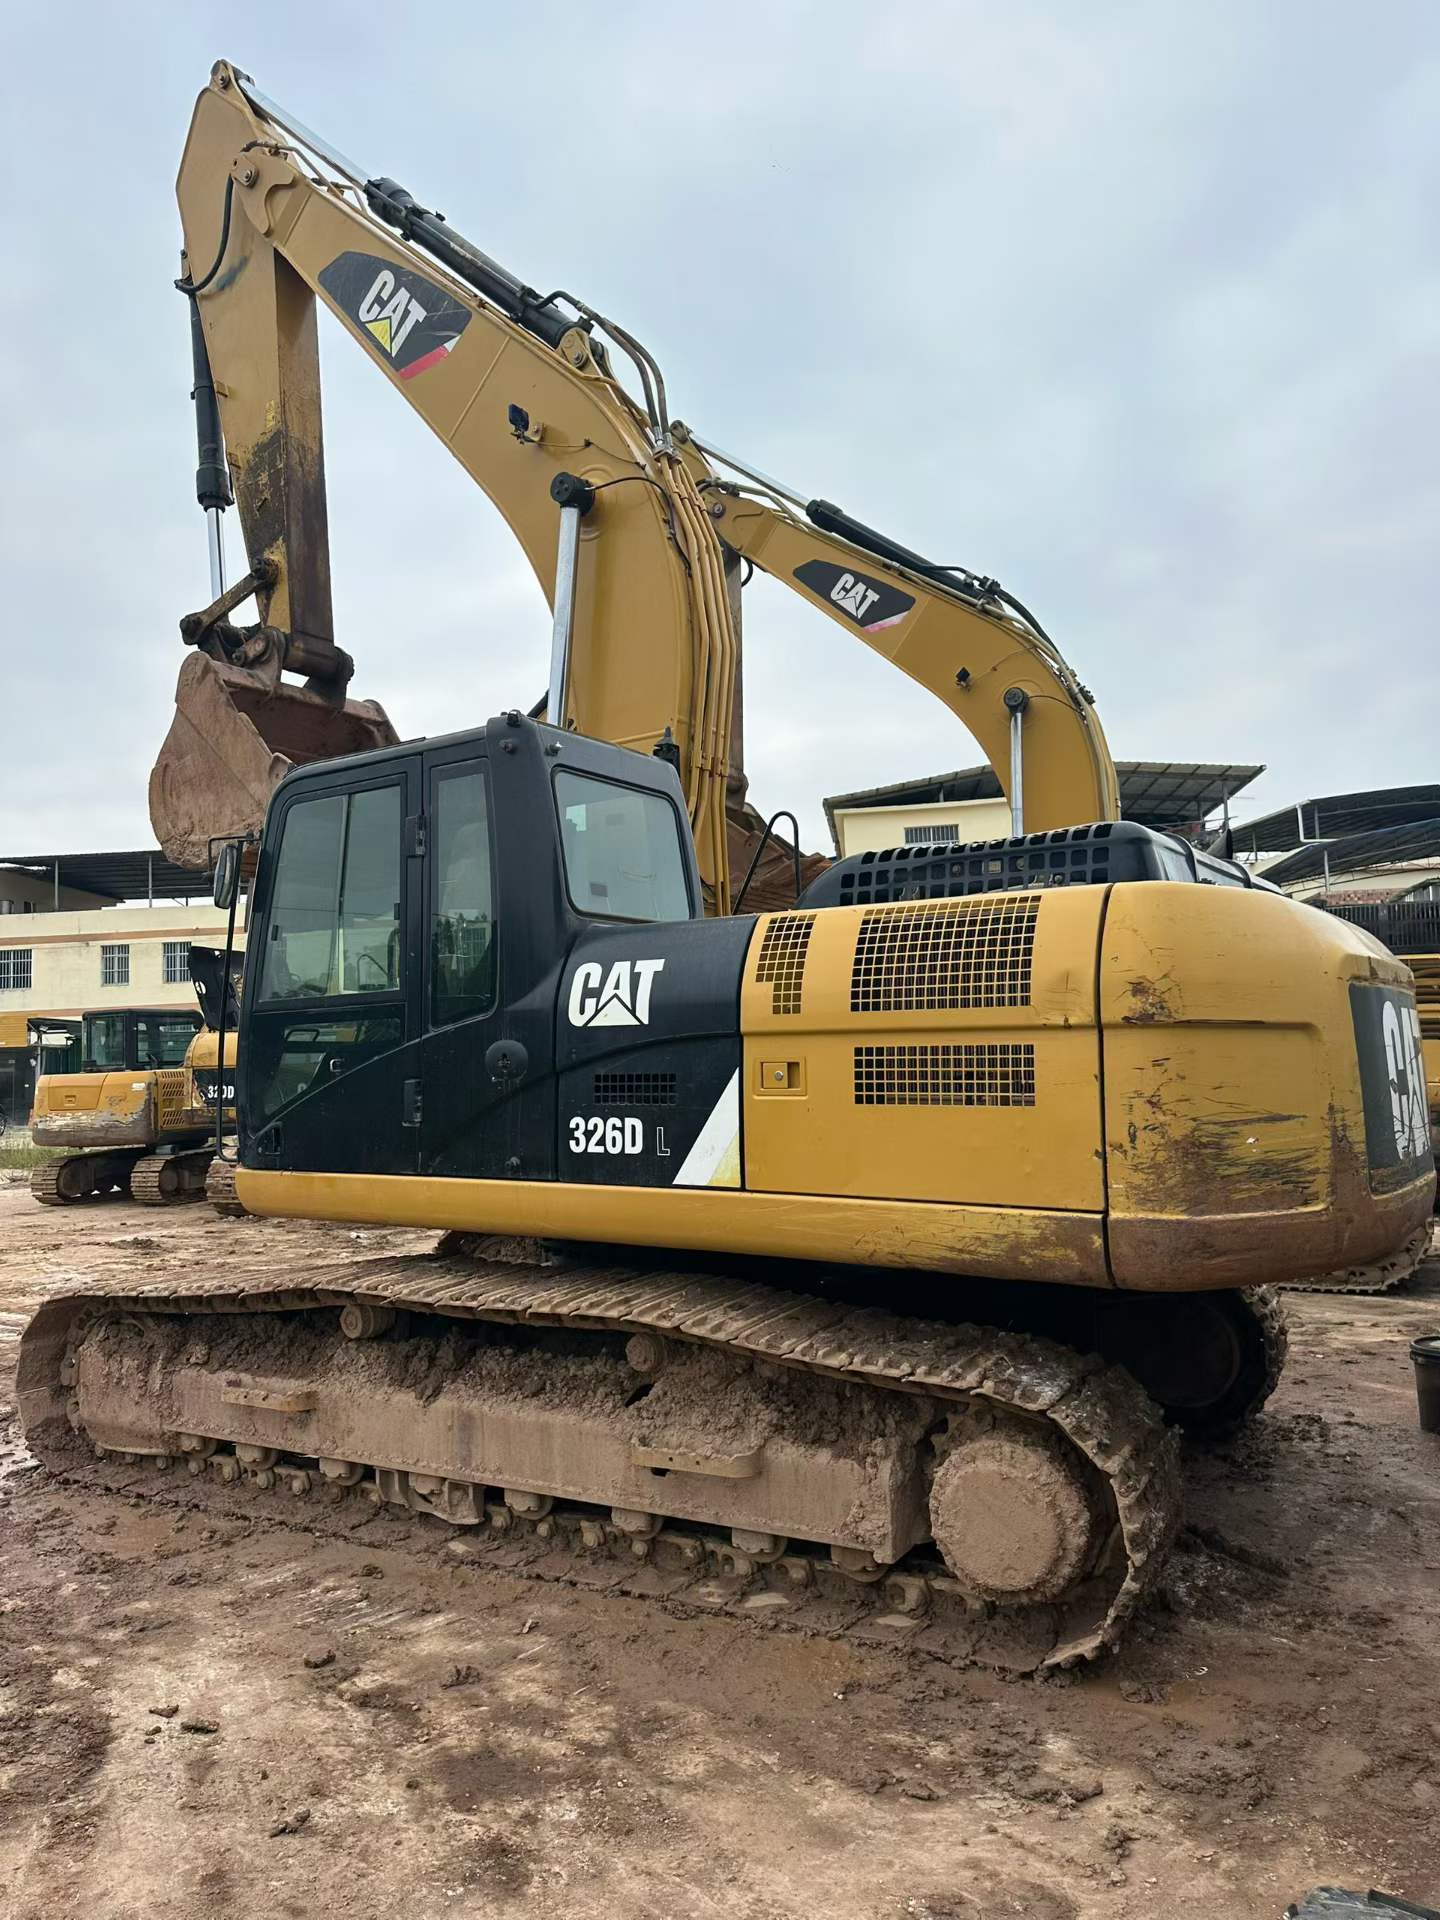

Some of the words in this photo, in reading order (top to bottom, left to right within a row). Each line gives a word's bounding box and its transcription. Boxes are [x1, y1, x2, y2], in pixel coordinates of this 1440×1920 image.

[358, 269, 428, 358] CAT
[830, 572, 880, 619] CAT
[568, 958, 666, 1028] CAT
[569, 1116, 643, 1155] 326D
[656, 1126, 671, 1156] L
